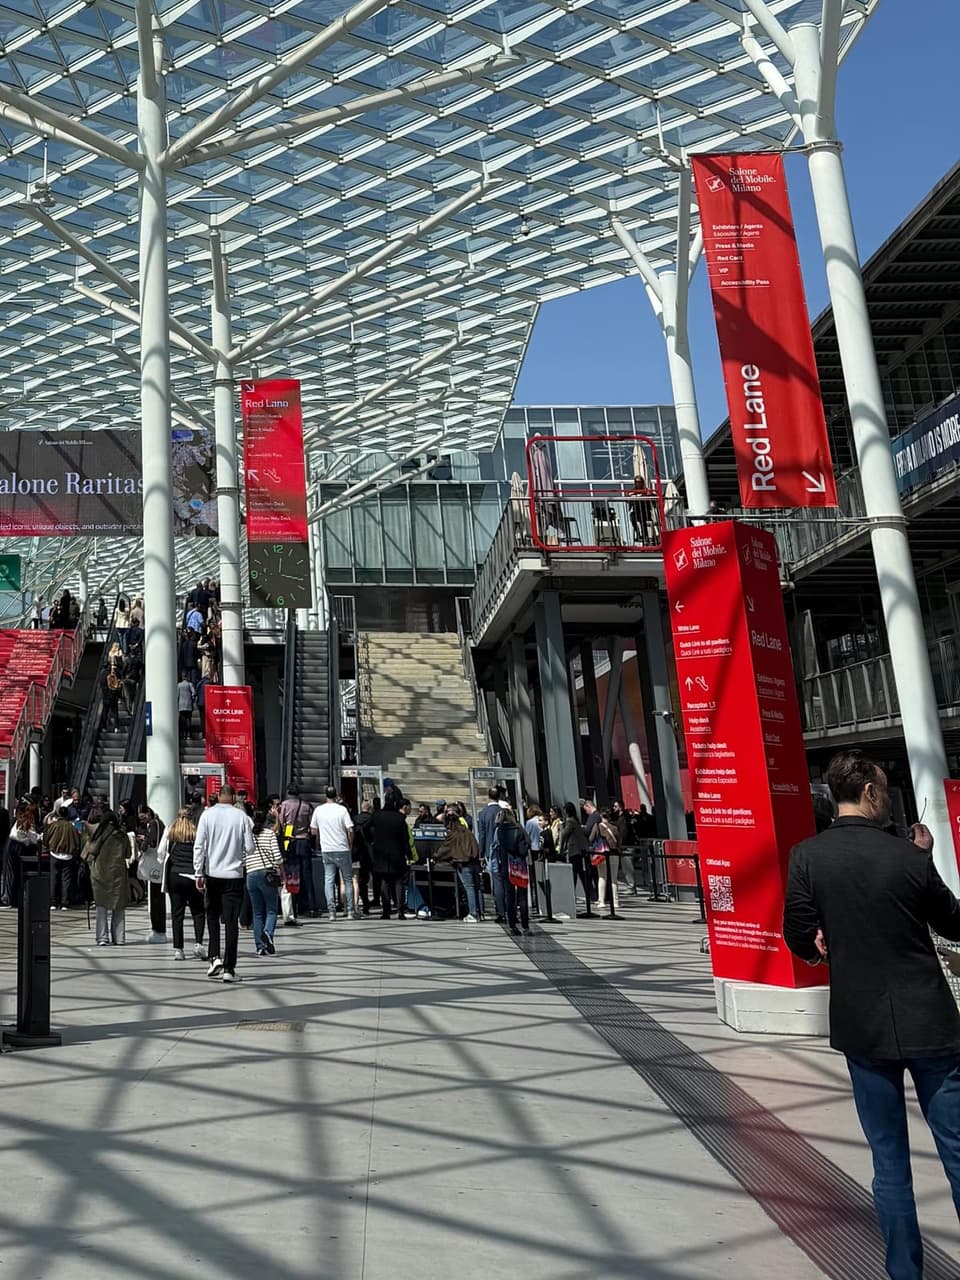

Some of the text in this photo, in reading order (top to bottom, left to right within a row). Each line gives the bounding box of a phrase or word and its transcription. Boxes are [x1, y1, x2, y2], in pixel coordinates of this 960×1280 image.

[729, 167, 757, 176] Salone
[730, 176, 744, 184] del
[732, 184, 761, 193] Milano
[245, 400, 264, 408] Red
[741, 364, 776, 491] Red Lane
[934, 426, 943, 454] IS
[65, 472, 143, 494] Raritas
[32, 524, 54, 532] unique
[690, 537, 712, 547] Salone
[273, 544, 283, 554] 12
[692, 548, 702, 558] del
[693, 559, 716, 569] Milano
[251, 570, 258, 579] 9
[277, 596, 284, 605] 6
[751, 630, 782, 650] Red Lane
